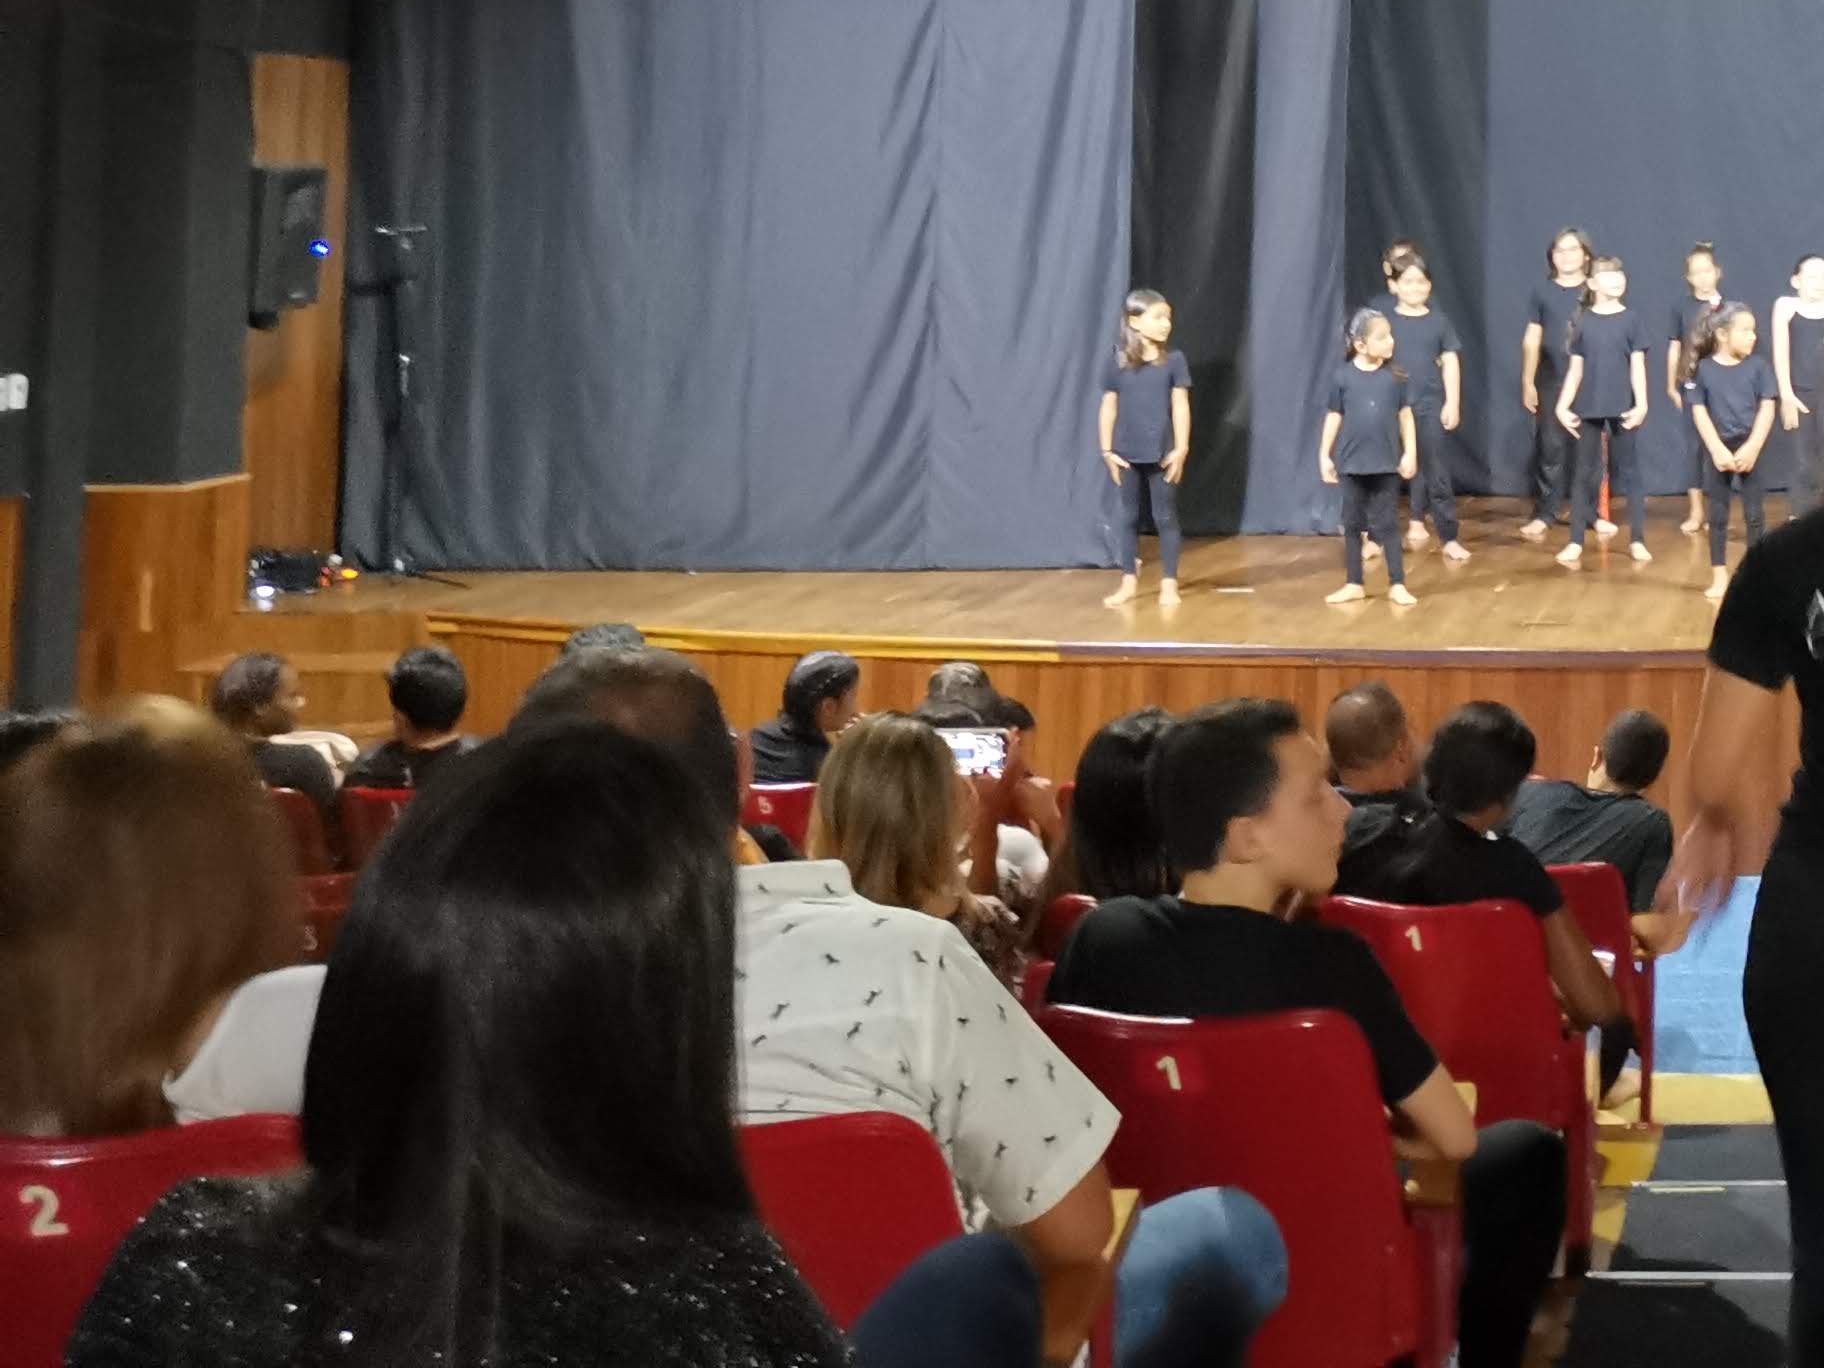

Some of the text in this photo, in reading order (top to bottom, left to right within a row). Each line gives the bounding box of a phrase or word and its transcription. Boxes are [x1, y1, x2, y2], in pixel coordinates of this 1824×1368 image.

[1404, 925, 1423, 952] 1
[1156, 1055, 1182, 1091] 1
[18, 1184, 70, 1238] 2
